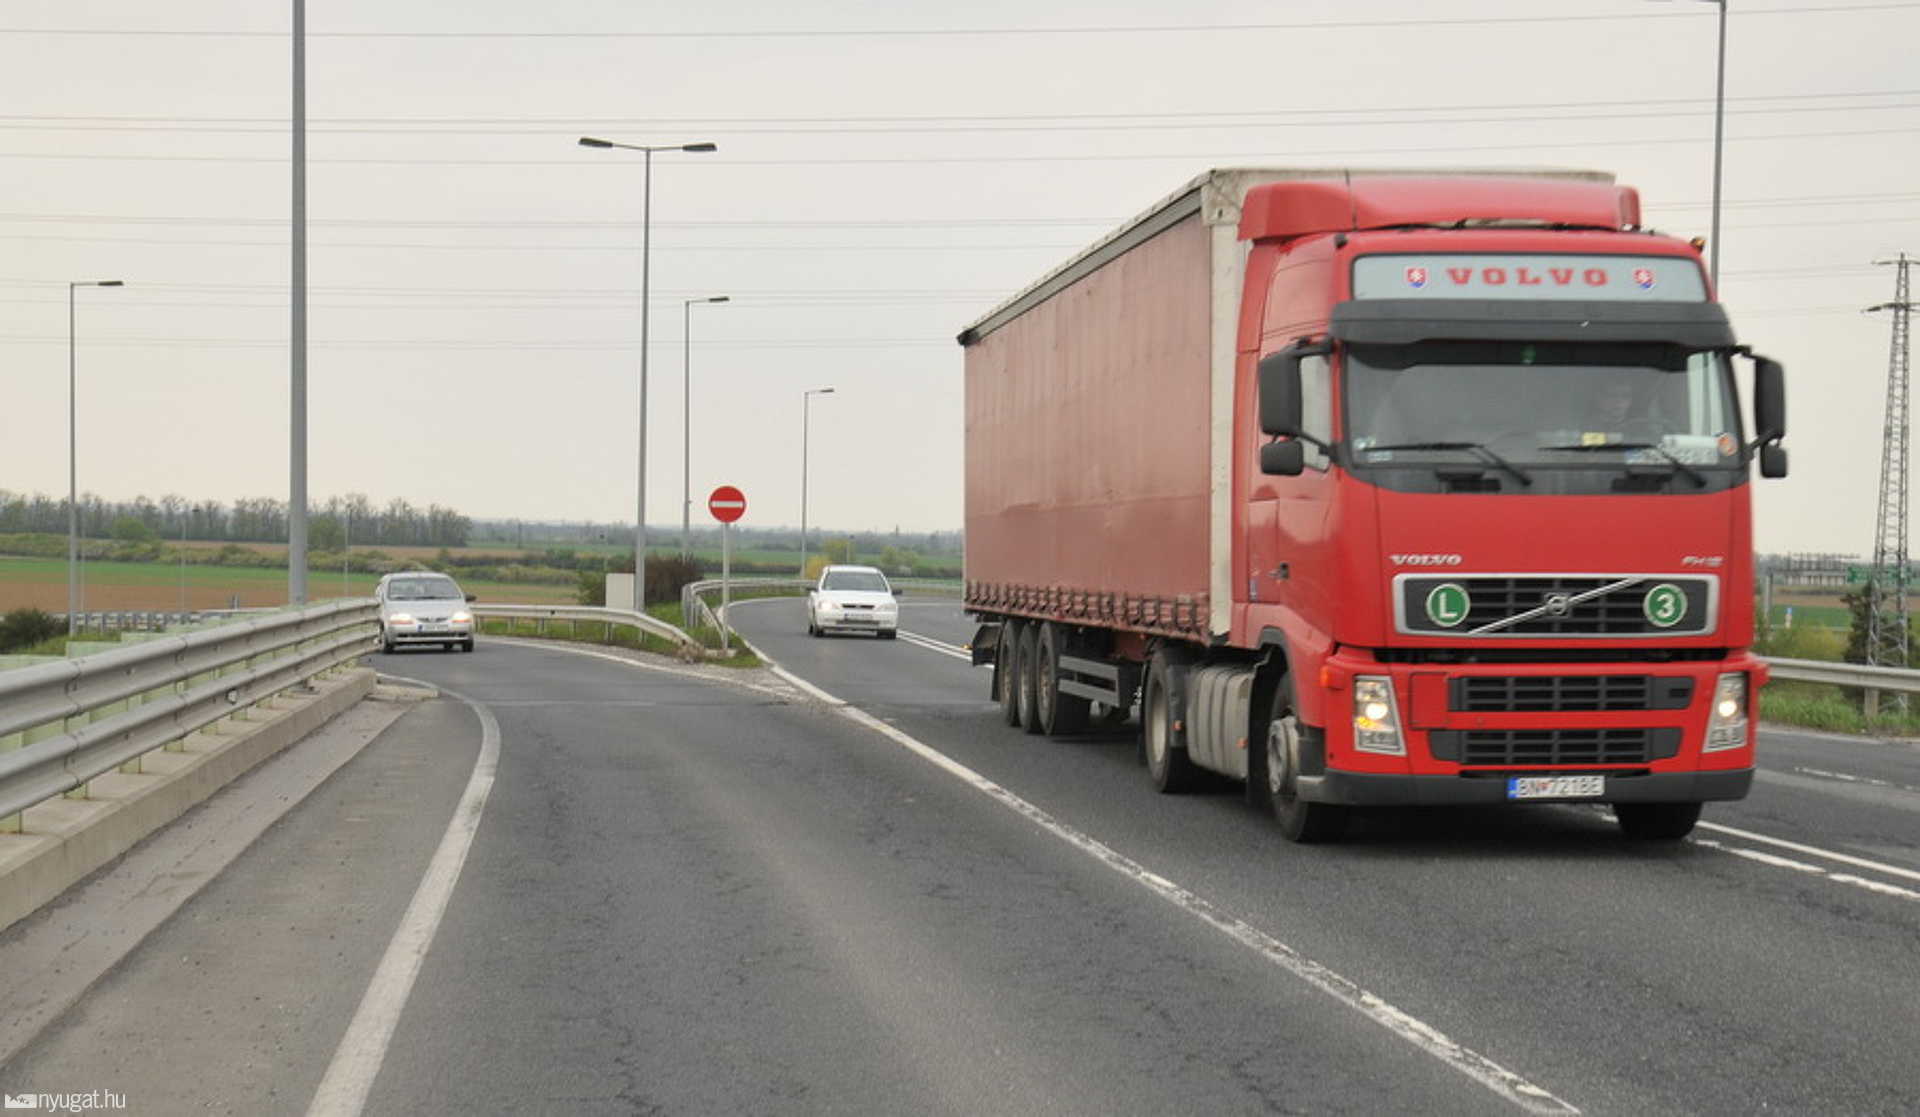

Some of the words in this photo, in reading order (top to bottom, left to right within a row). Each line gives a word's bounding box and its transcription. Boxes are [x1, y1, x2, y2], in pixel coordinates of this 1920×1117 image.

[1446, 267, 1609, 286] VOLVO
[1390, 554, 1462, 566] VOLVO
[1439, 591, 1458, 619] L
[1656, 592, 1675, 619] 3
